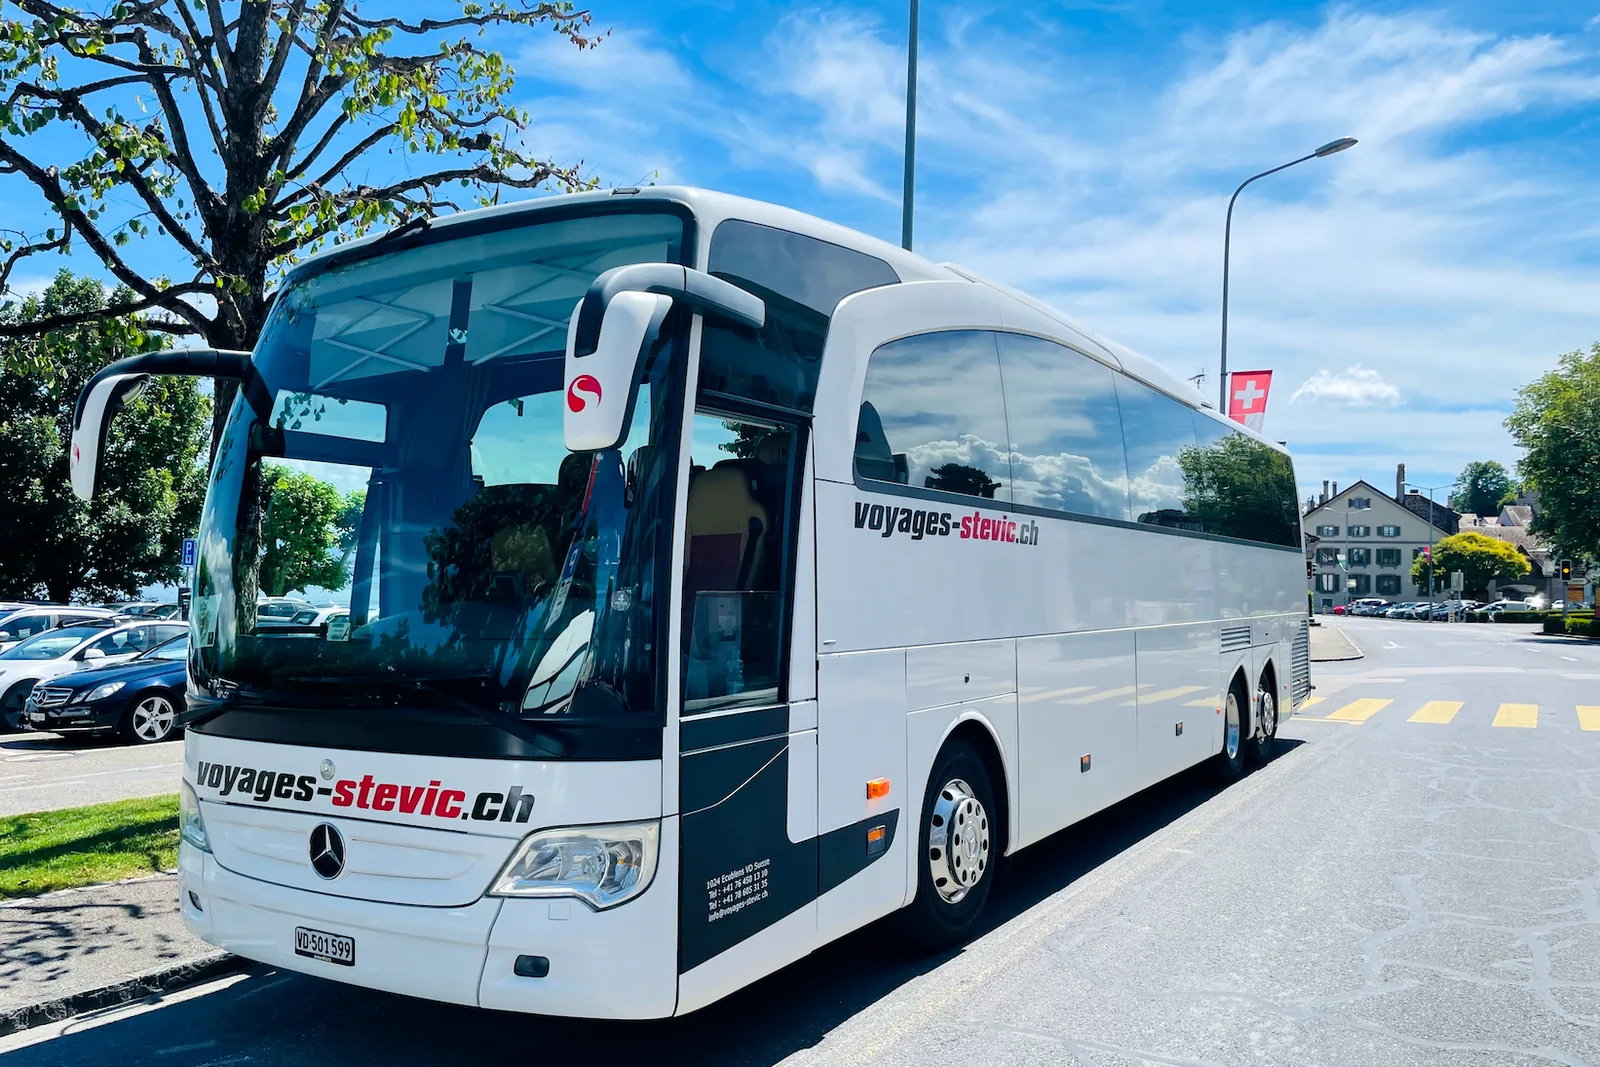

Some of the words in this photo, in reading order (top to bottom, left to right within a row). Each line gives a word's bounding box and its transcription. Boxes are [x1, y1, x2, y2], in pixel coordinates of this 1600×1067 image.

[854, 502, 1039, 546] voyages-stevic.ch
[186, 541, 193, 554] P
[197, 761, 536, 824] voyages-stevic.ch
[707, 877, 720, 890] 1024
[745, 864, 753, 874] VD
[754, 859, 770, 870] Suisse
[709, 889, 717, 899] Tel
[722, 883, 733, 893] +41
[735, 879, 742, 889] 76
[743, 875, 752, 885] 450
[754, 872, 760, 881] 13
[761, 868, 768, 878] 10
[709, 900, 717, 910] Tel
[722, 894, 733, 904] +41
[754, 882, 760, 892] 31
[761, 879, 768, 888] 35
[709, 890, 768, 922] info@voyages-stevicch
